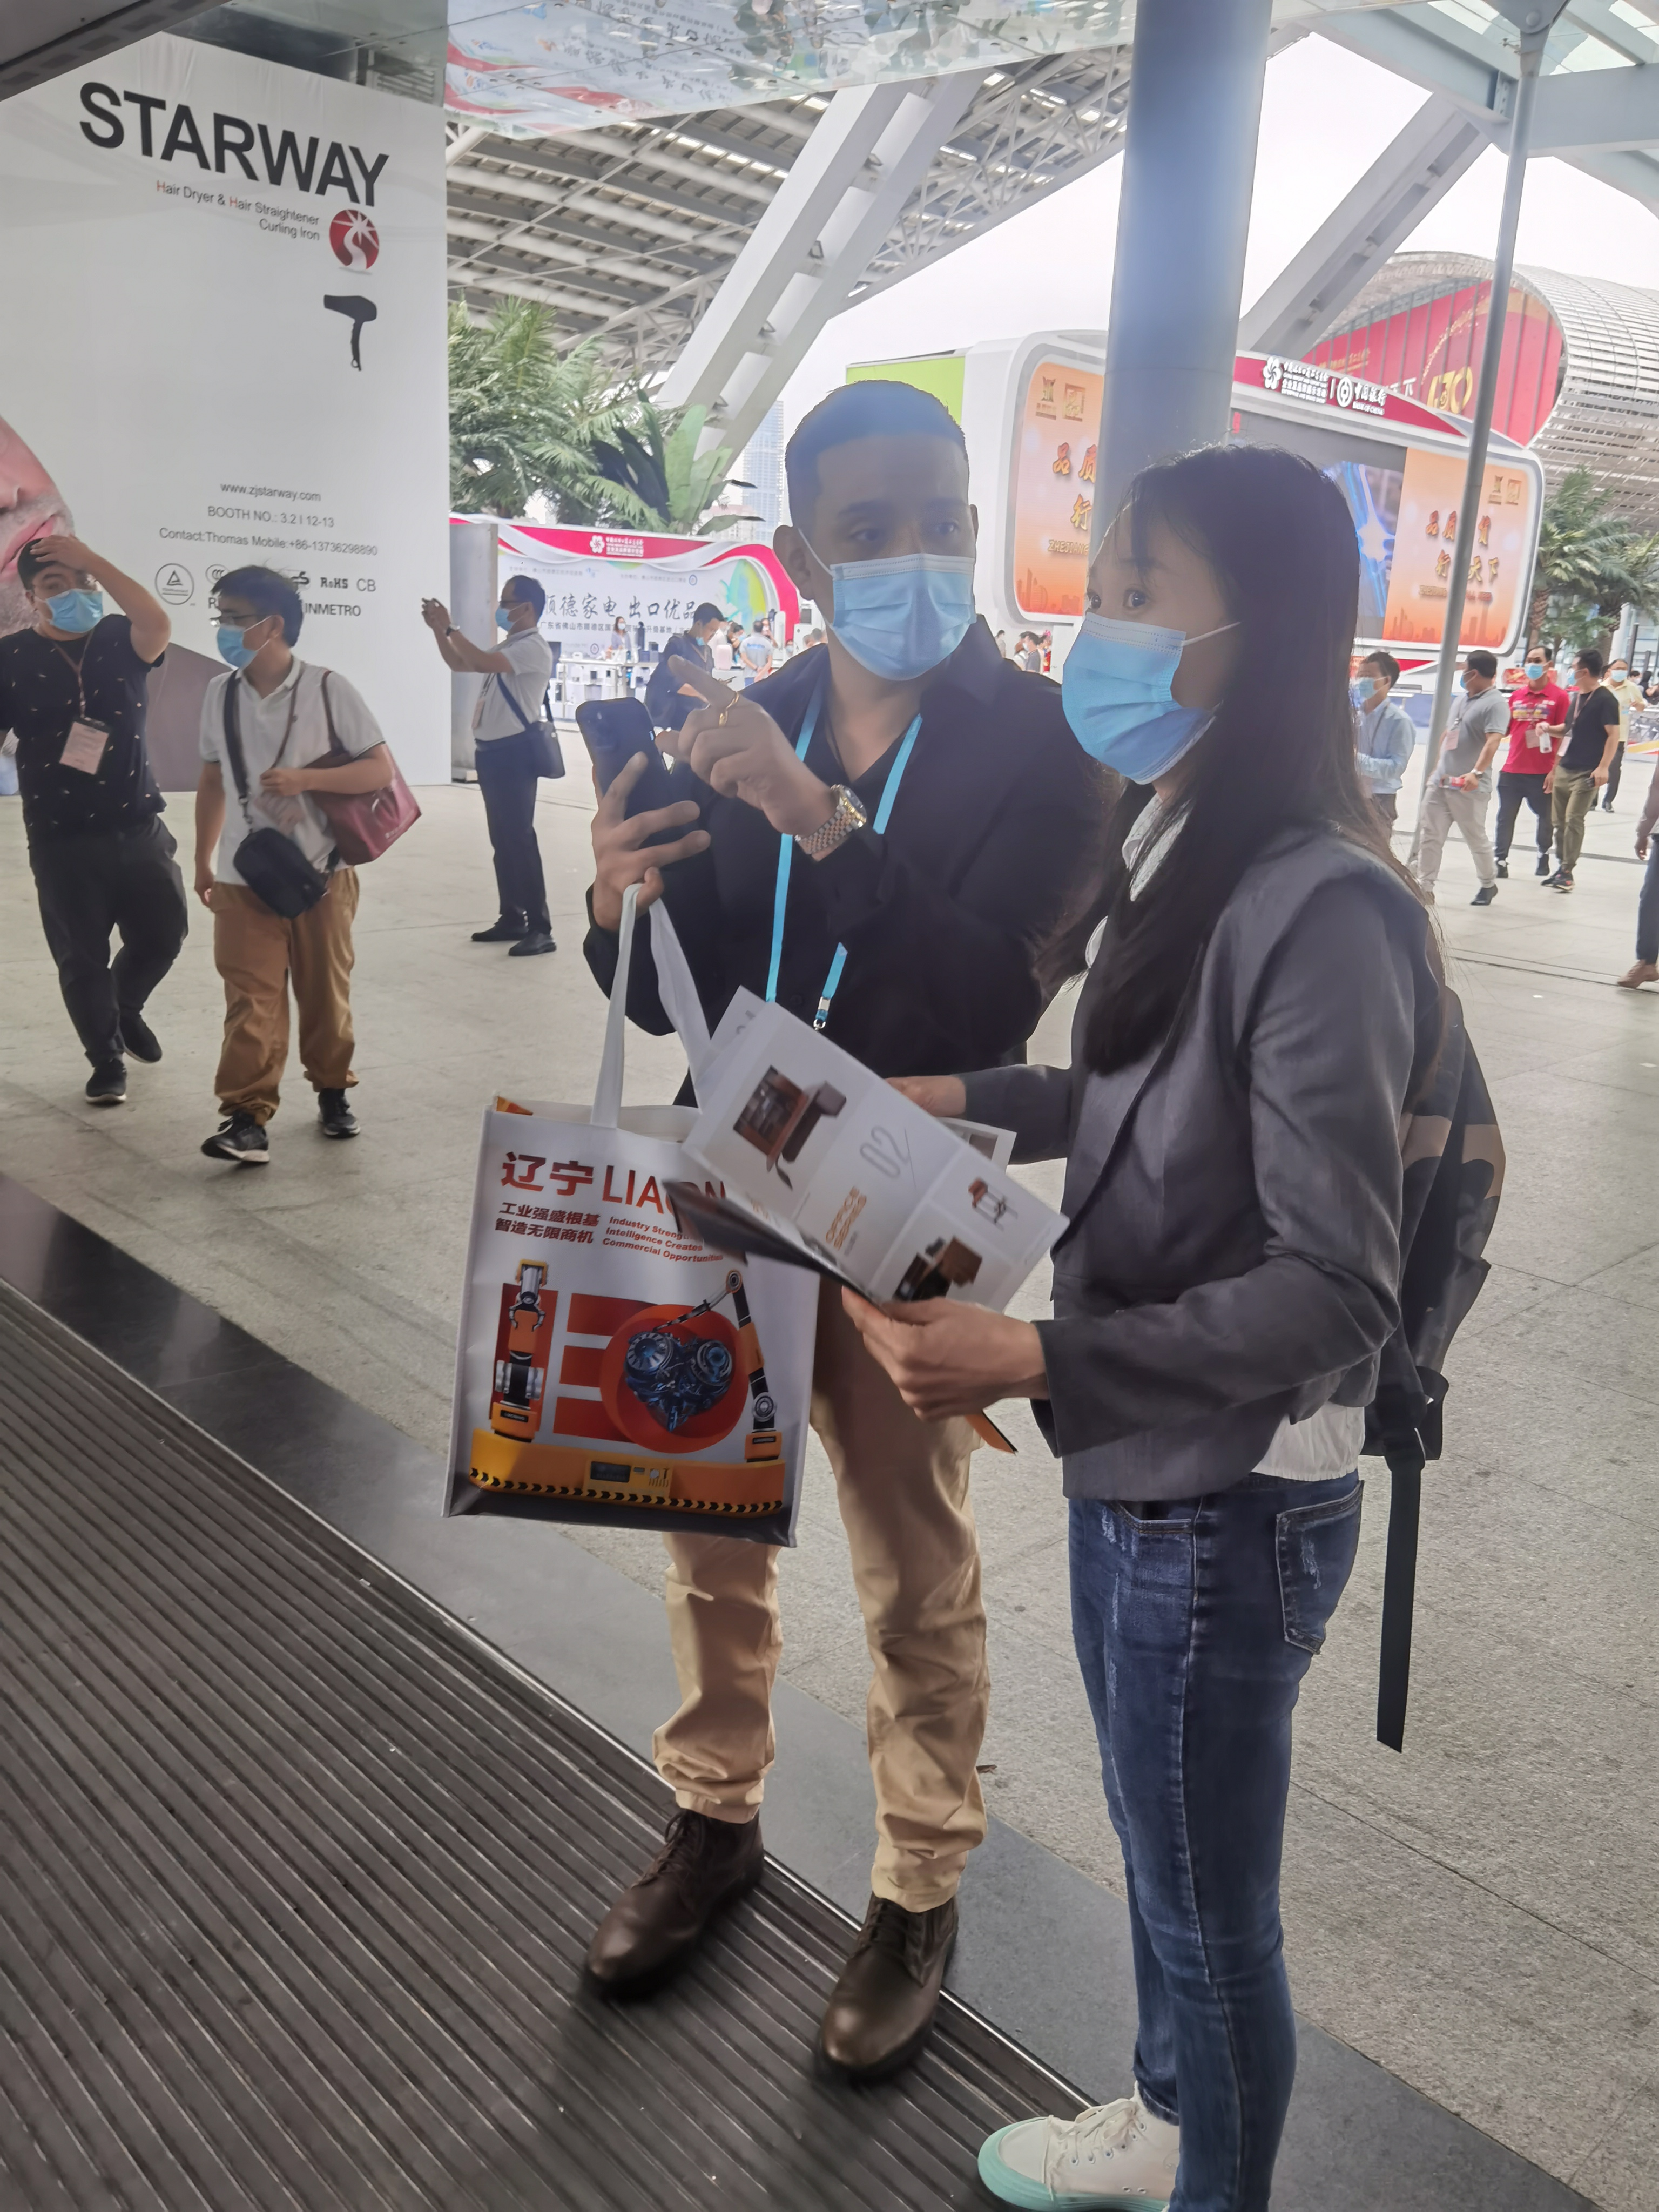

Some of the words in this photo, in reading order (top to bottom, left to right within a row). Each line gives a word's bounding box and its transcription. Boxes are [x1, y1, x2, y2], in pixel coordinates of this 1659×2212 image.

[80, 82, 389, 207] STARWAY
[157, 180, 180, 196] Hair
[184, 186, 214, 203] Dryer
[218, 194, 226, 205] &
[230, 196, 252, 210] Hair
[255, 201, 320, 226] Straightener
[259, 218, 296, 239] Curling
[300, 226, 320, 241] Iron
[220, 483, 322, 502] www.zjstarway.com
[208, 505, 251, 520] BOOTH
[306, 515, 335, 528] 12-13
[356, 578, 376, 592] CB
[305, 603, 361, 617] INMETRO
[501, 1151, 594, 1196] 辽宁
[498, 1202, 601, 1227] 工业强盛根基
[609, 1216, 650, 1232] Industry
[495, 1217, 594, 1244] 智造无限商机
[606, 1226, 663, 1245] Intelligence
[665, 1240, 703, 1251] Creates
[602, 1237, 661, 1255] Commercial
